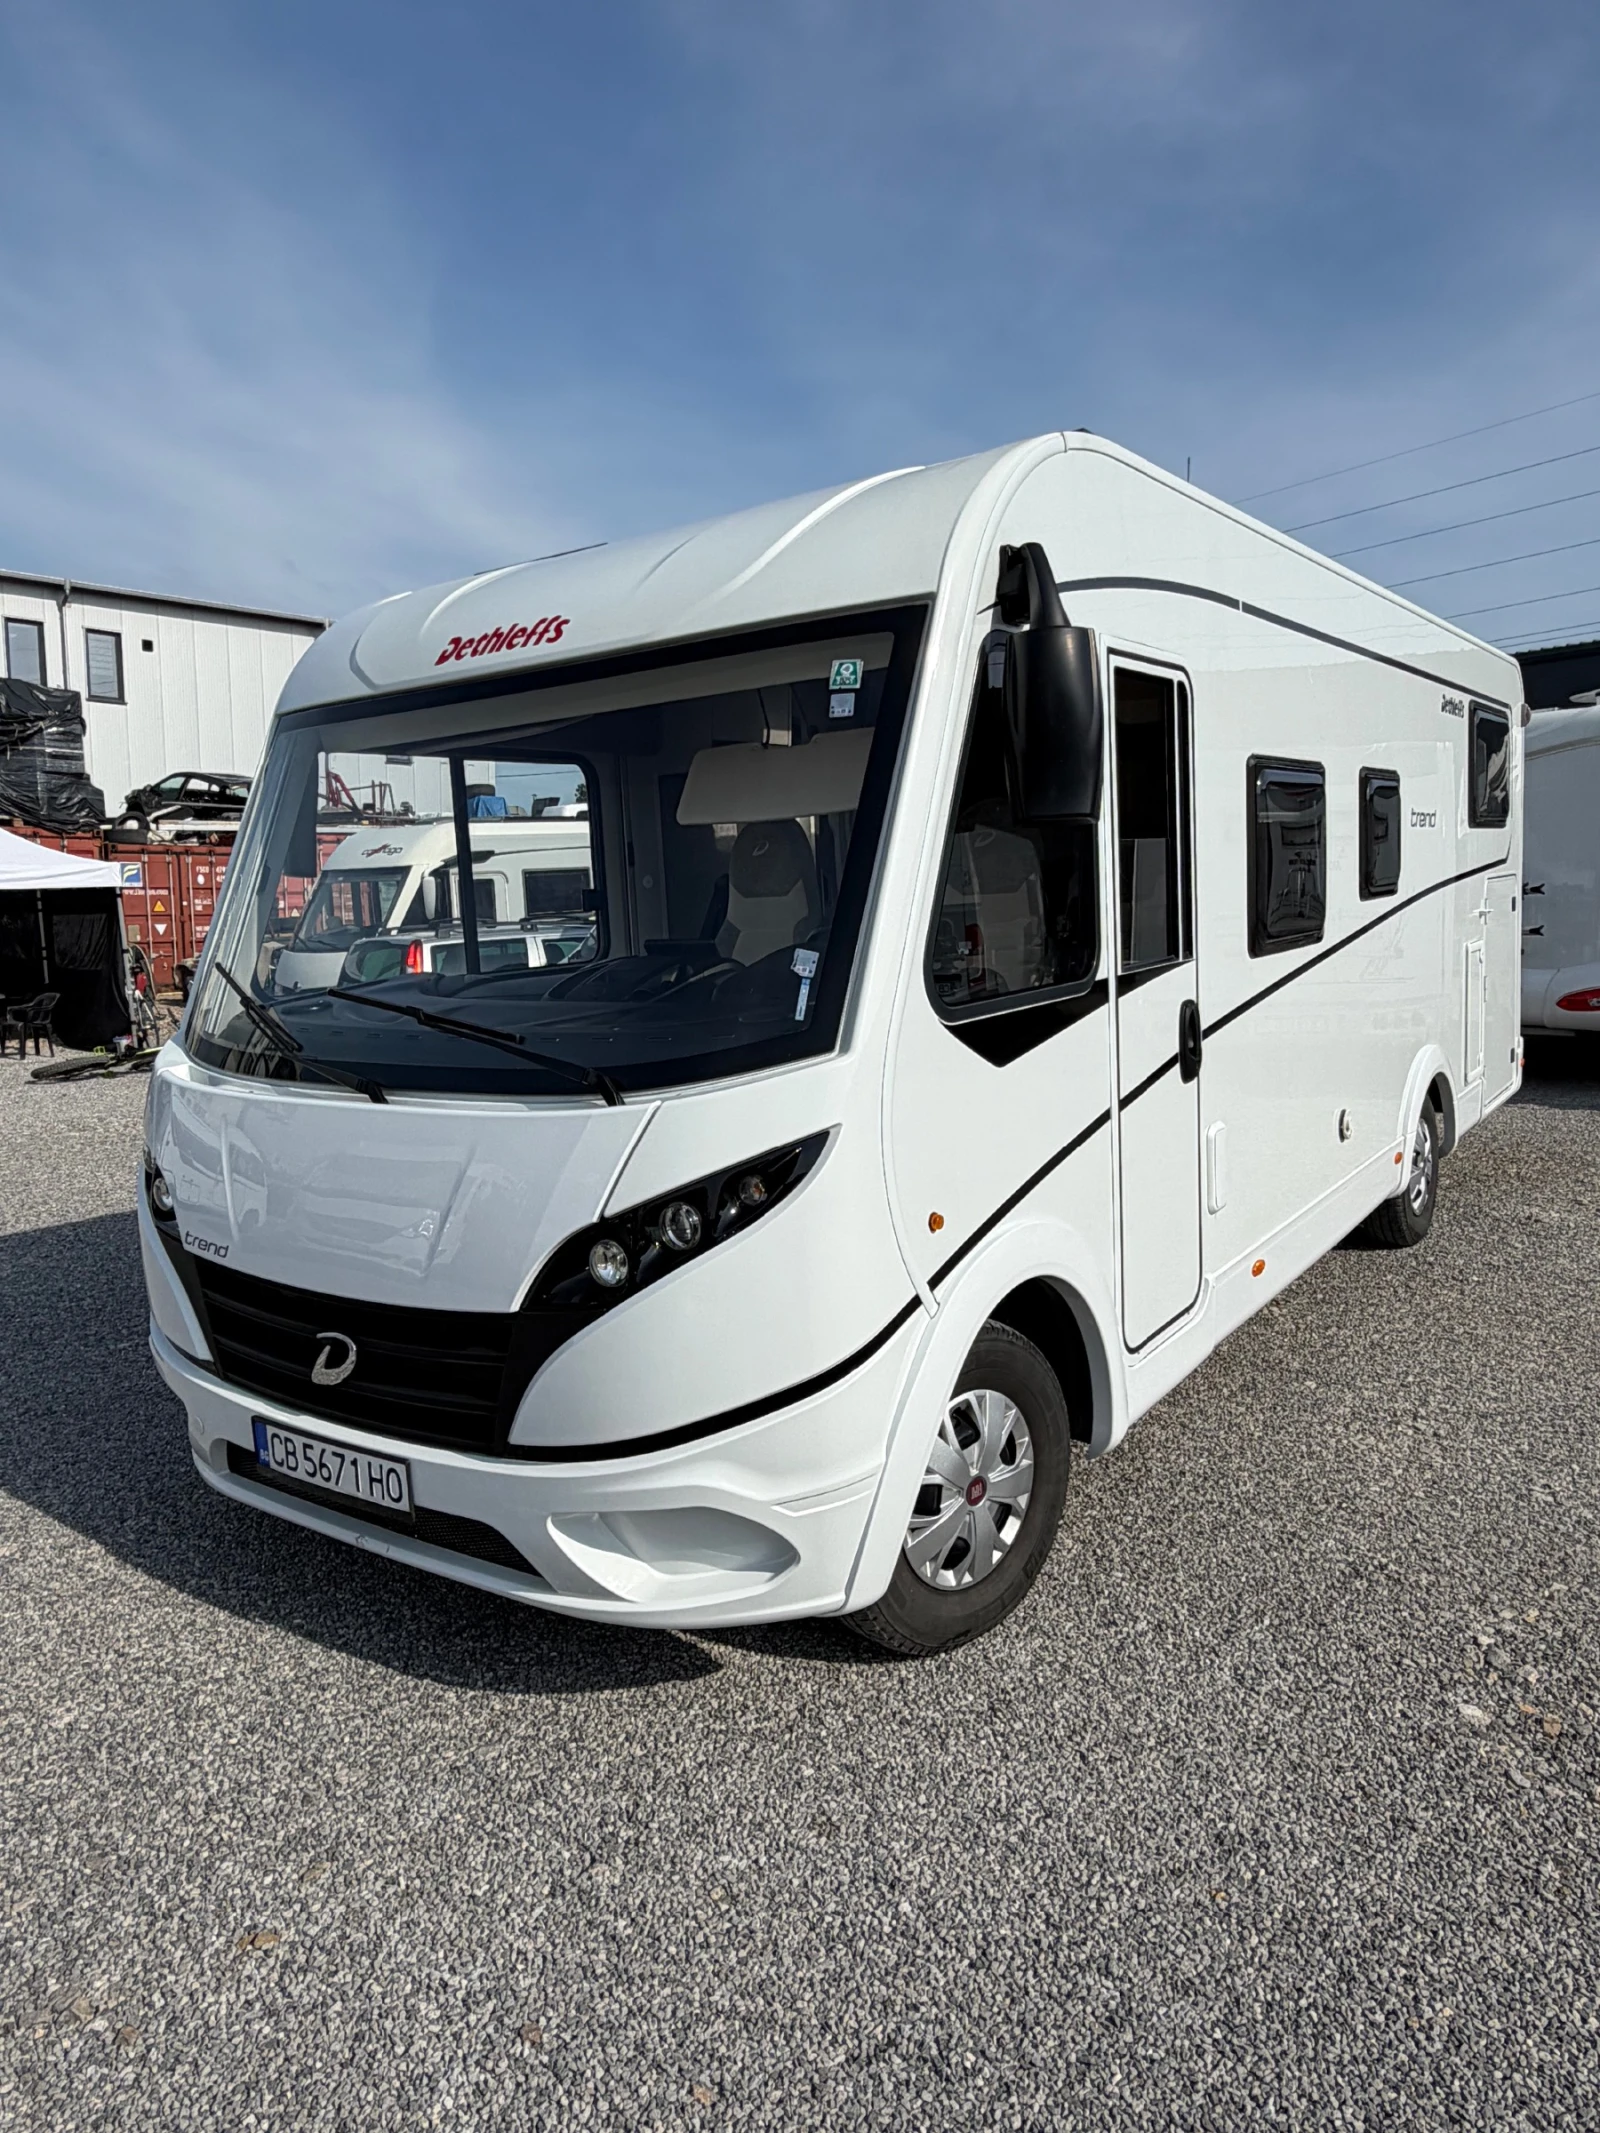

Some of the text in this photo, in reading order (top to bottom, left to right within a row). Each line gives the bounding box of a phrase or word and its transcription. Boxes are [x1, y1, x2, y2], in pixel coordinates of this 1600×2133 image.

[434, 614, 571, 666] Dethleffs
[1410, 807, 1436, 828] trend
[184, 1230, 230, 1259] trend
